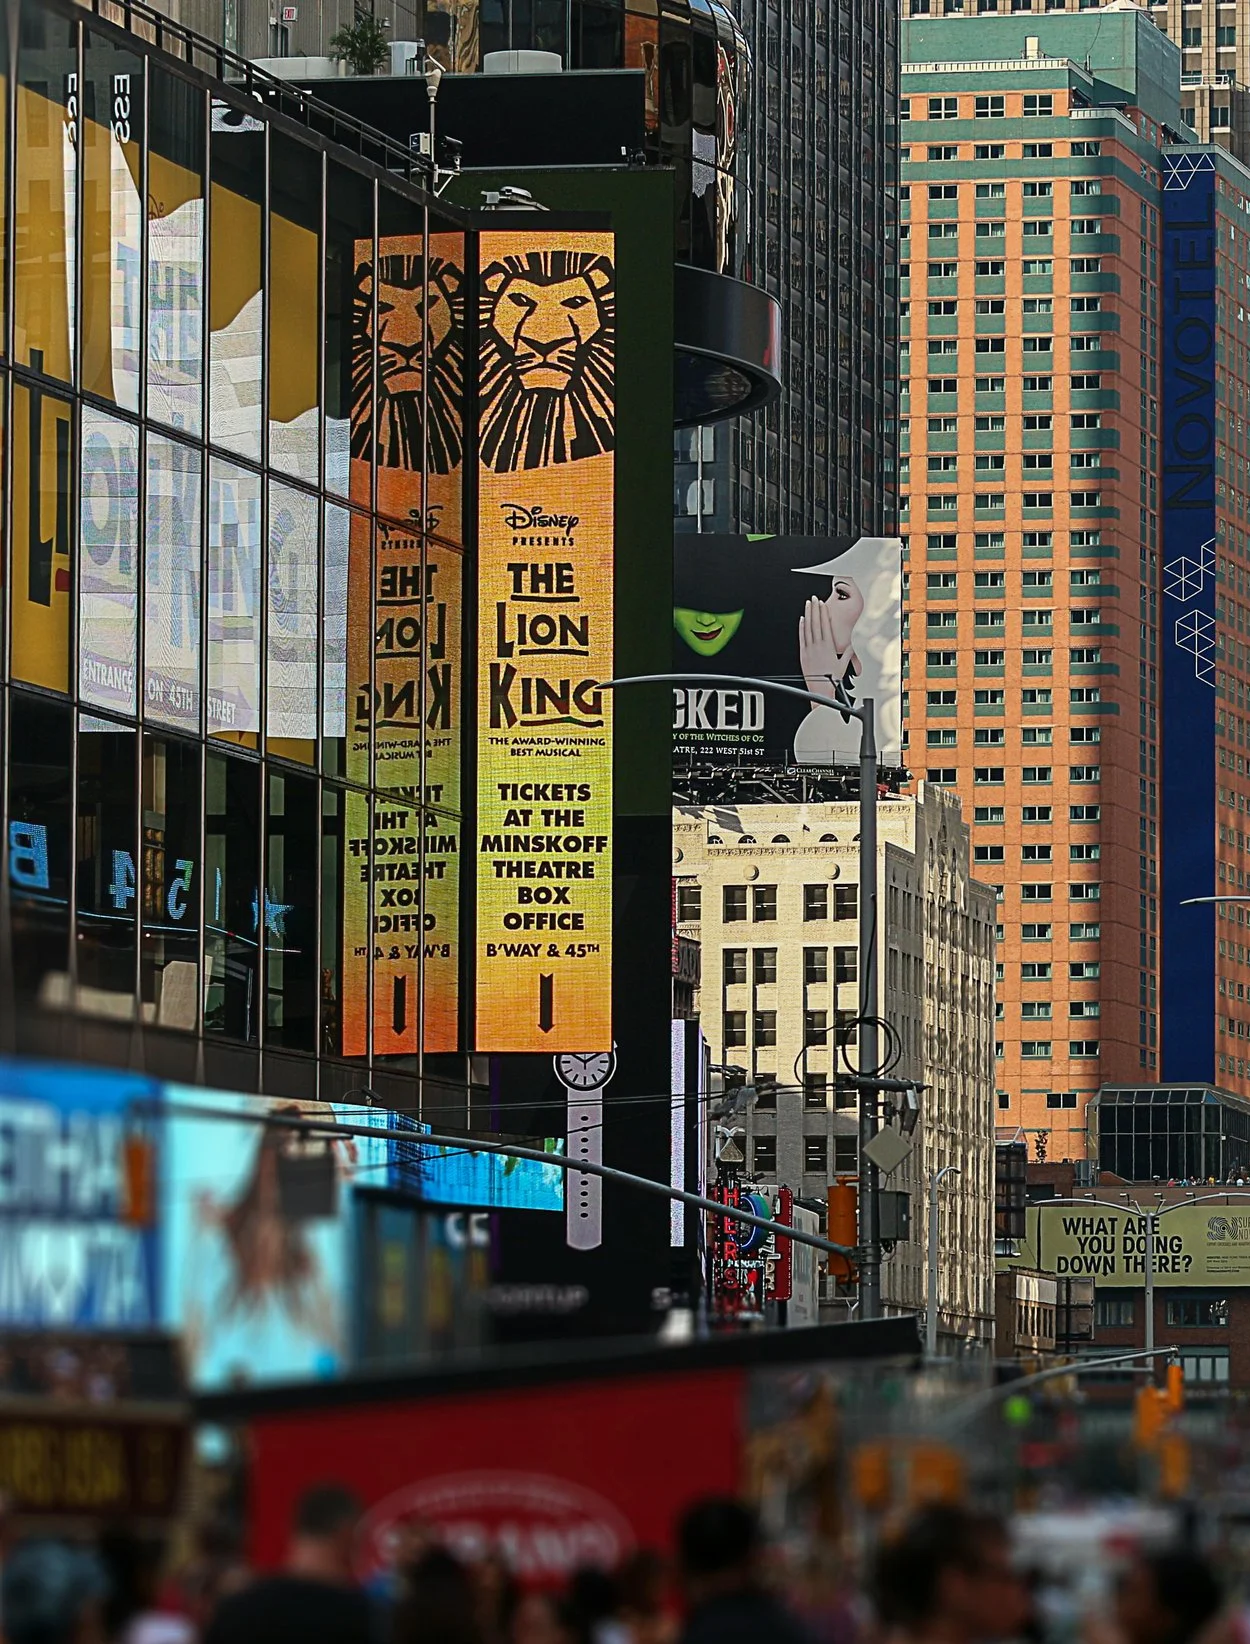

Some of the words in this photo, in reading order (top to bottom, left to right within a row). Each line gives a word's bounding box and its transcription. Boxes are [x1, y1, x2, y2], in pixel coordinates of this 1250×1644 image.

[1165, 193, 1214, 509] NOVOTEL
[500, 503, 579, 536] Disney
[512, 537, 575, 546] PRESENTS
[507, 562, 575, 593] THE
[496, 602, 589, 658] LION
[83, 657, 133, 694] ENTRANCE
[148, 677, 164, 702] ON
[168, 685, 194, 711] 45TH
[207, 695, 237, 725] STREET
[489, 662, 603, 729] KING
[488, 737, 509, 746] THE
[511, 737, 606, 746] AWARD-WINNING
[679, 733, 689, 741] OF
[690, 733, 705, 741] THE
[510, 748, 533, 757] BEST
[535, 748, 581, 757] MUSICAL
[700, 747, 713, 755] 222
[716, 747, 738, 756] WEST
[755, 748, 765, 756] ST
[498, 783, 591, 801] TICKETS
[503, 809, 533, 827] AT
[541, 809, 585, 827] THE
[480, 834, 608, 853] MINSKOFF
[493, 860, 595, 878] THEATRE
[518, 886, 571, 905] BOX
[503, 912, 585, 931] OFFICE
[486, 943, 542, 958] B'WAY
[547, 943, 561, 958] &
[565, 943, 600, 958] 45TH
[1062, 1216, 1118, 1236] WHAT
[1123, 1216, 1160, 1236] ARE
[1077, 1236, 1116, 1255] YOU
[1057, 1255, 1116, 1275] DOWN
[1123, 1254, 1193, 1274] THERE?
